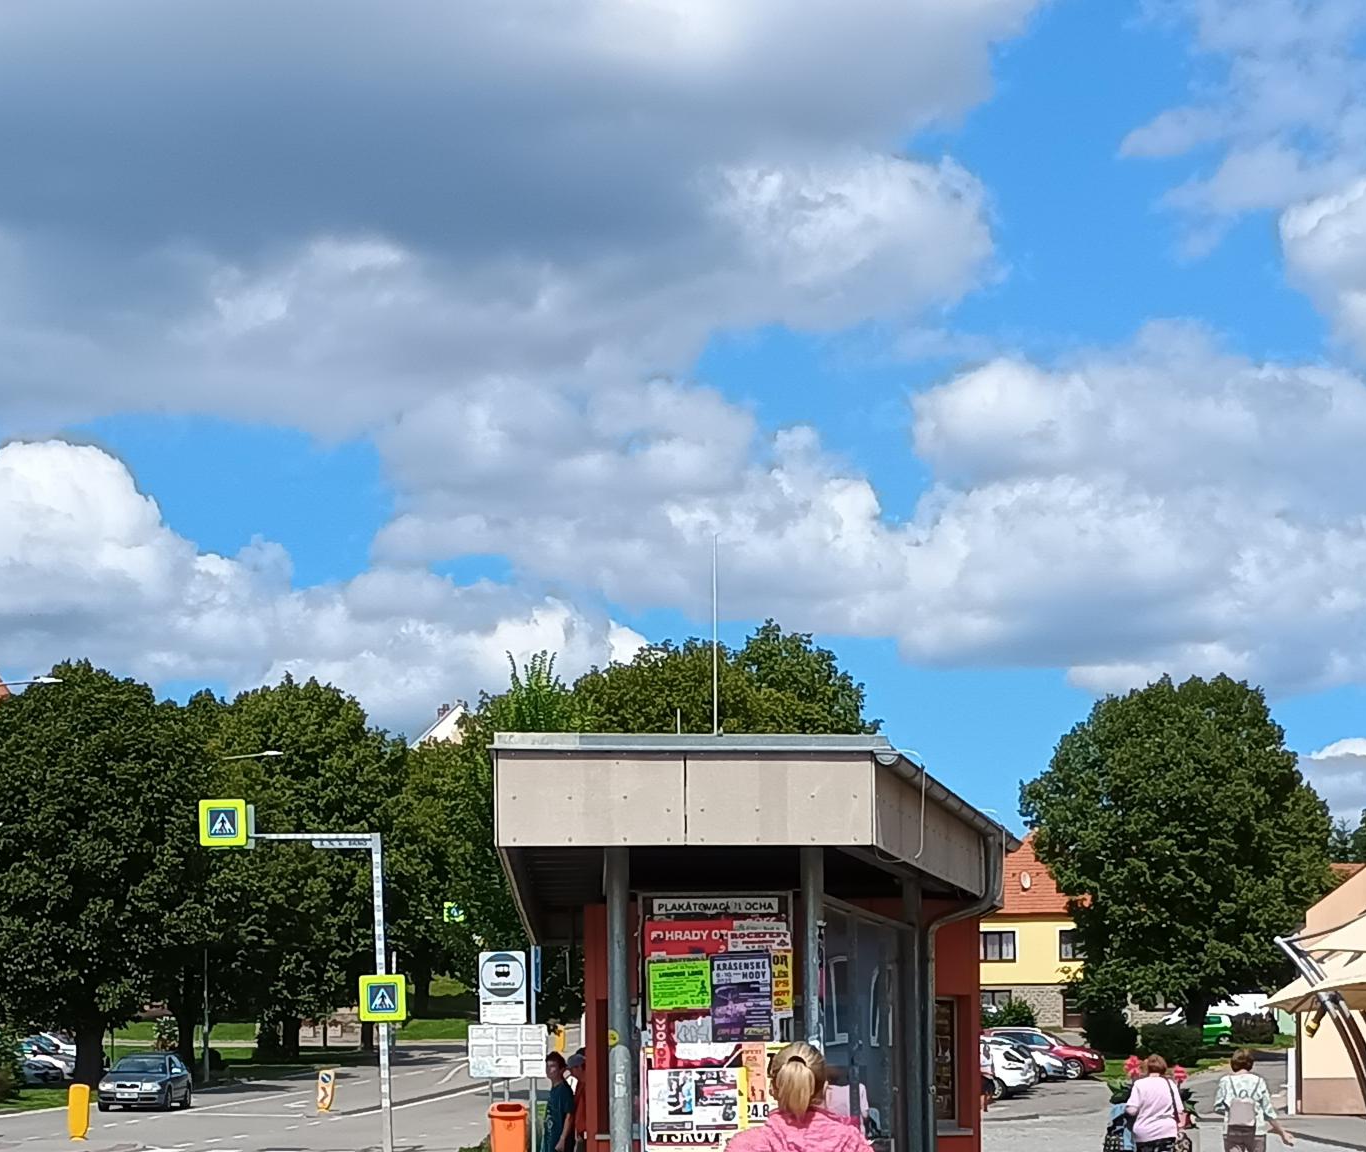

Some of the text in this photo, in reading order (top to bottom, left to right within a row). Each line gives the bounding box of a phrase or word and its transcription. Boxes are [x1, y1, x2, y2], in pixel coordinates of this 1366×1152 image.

[733, 899, 774, 911] LOCHA
[665, 930, 709, 941] HRADY
[715, 959, 767, 971] KRÁSENSKÉ
